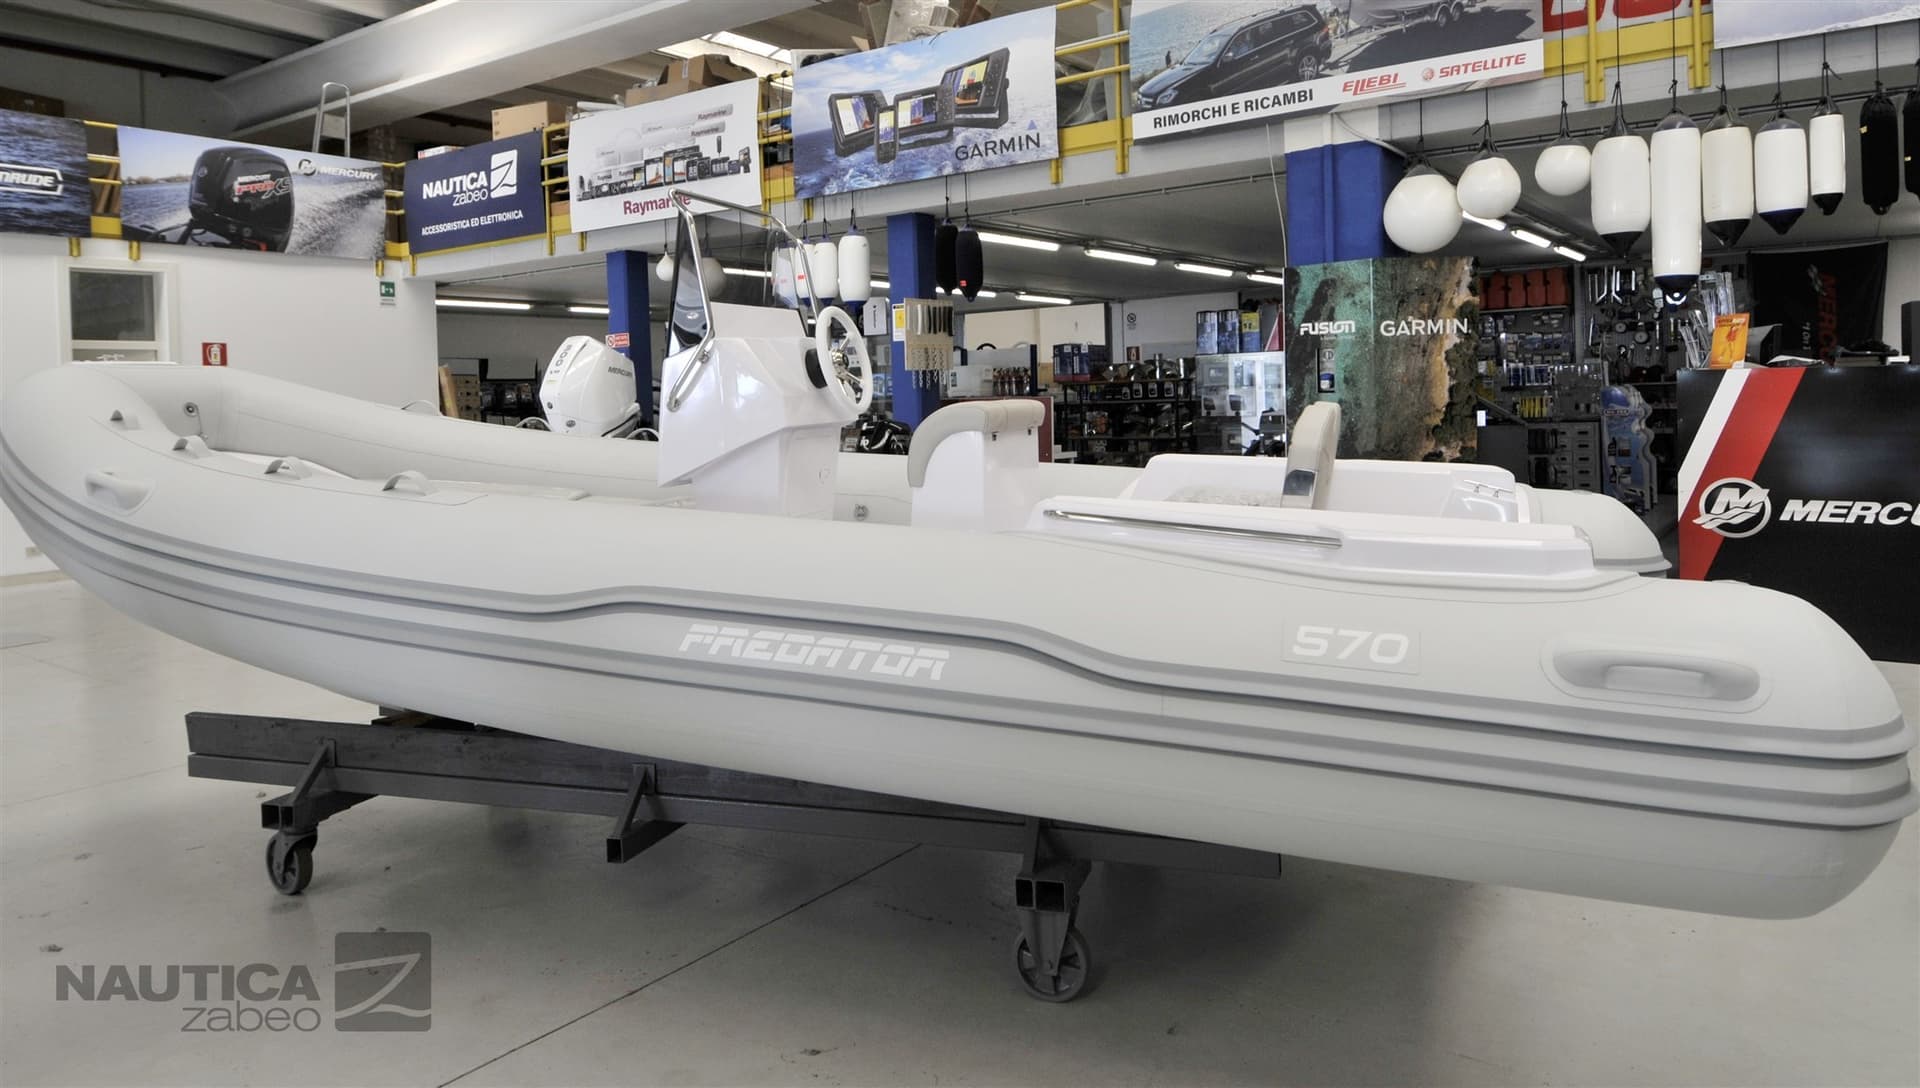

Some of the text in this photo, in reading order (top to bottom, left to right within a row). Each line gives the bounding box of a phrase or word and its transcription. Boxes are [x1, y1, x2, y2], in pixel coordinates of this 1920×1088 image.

[1439, 53, 1527, 78] SATELLITE
[1342, 72, 1401, 96] ELLEBI
[1153, 89, 1313, 129] RIMORCHI E RICAMBI
[954, 132, 1041, 161] GARMIN
[319, 166, 379, 180] MERCURY
[422, 170, 489, 200] NAUTICA
[452, 188, 489, 207] zabeo
[623, 196, 691, 216] Raymare
[421, 209, 524, 236] ACCESSORISTICA ED ELETTRONICA
[1300, 320, 1356, 335] FUSION
[1779, 499, 1920, 526] MERC
[679, 623, 950, 681] PREDATOR
[1293, 625, 1410, 664] 570
